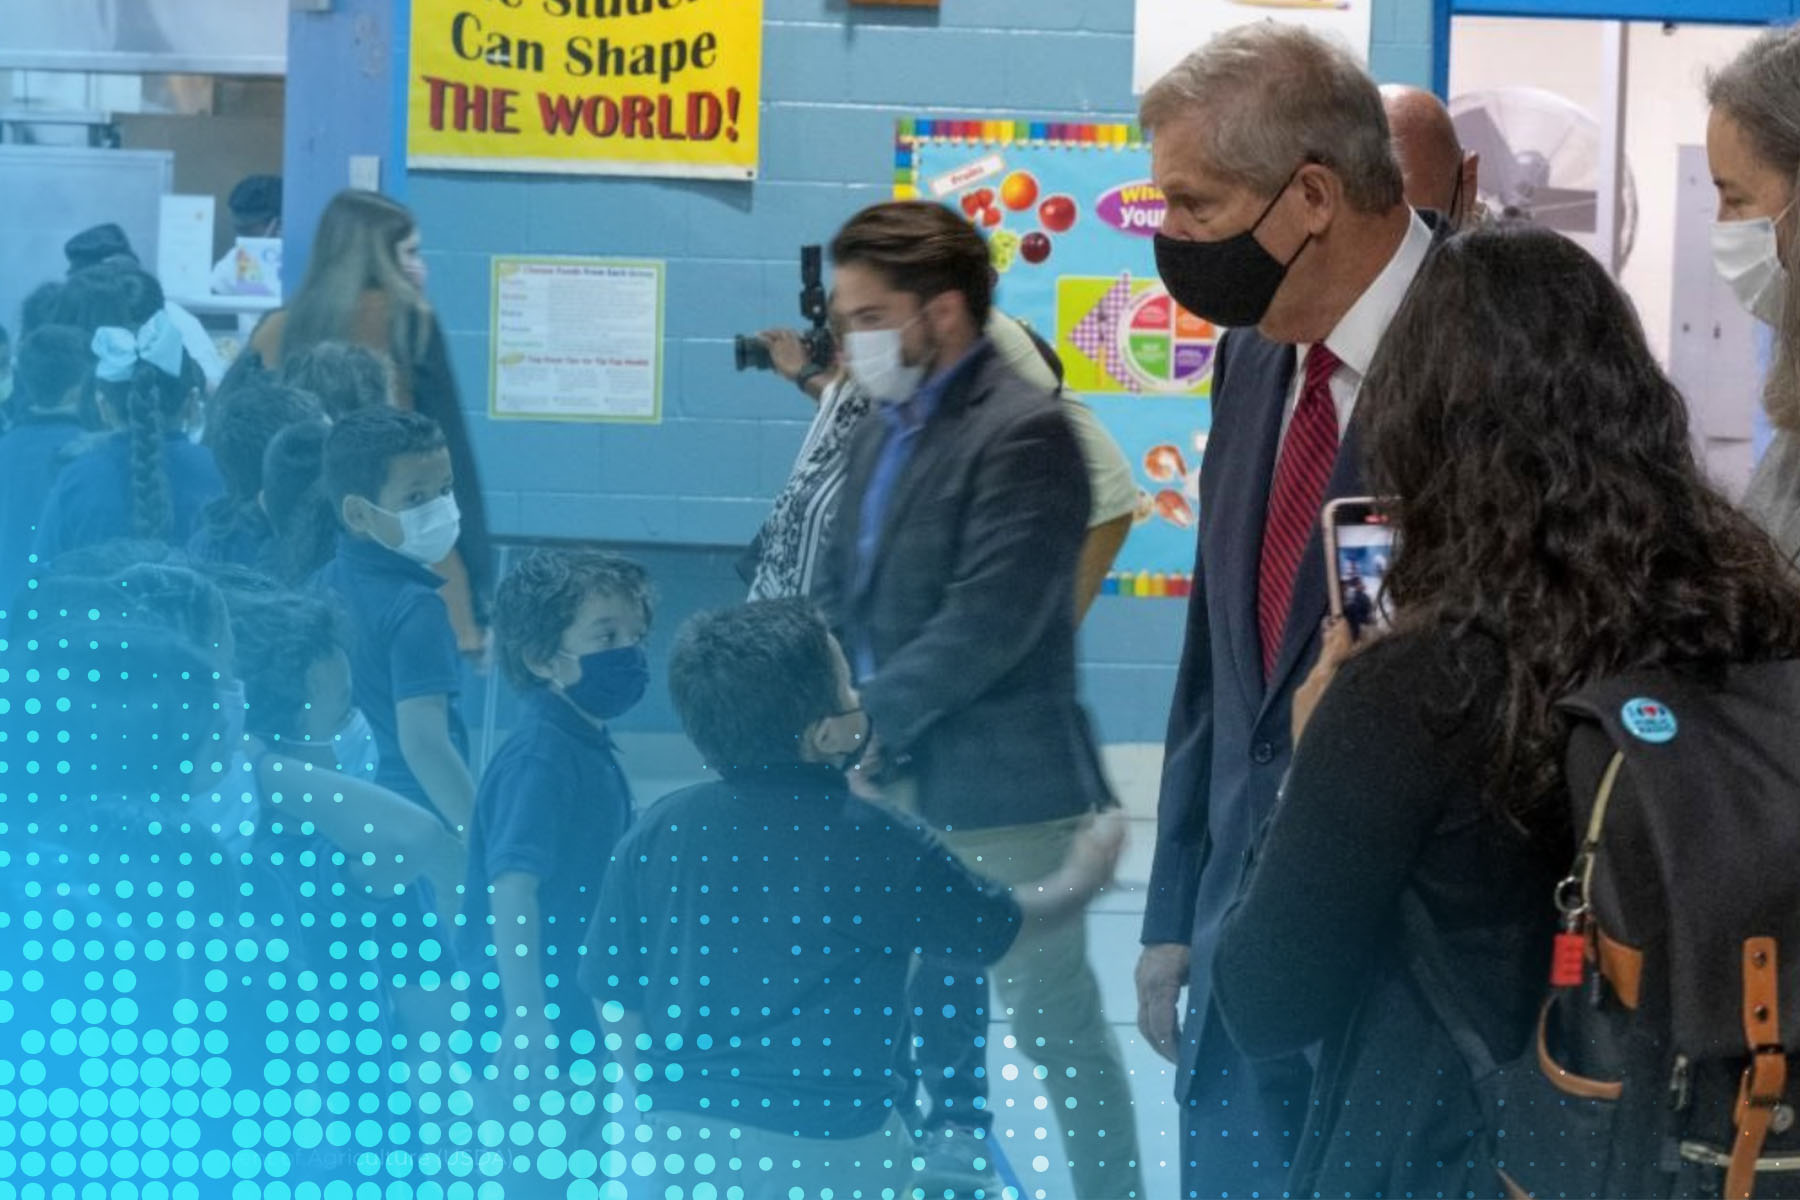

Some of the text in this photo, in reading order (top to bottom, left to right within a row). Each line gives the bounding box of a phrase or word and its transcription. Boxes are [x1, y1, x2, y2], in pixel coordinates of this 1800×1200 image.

[451, 11, 717, 84] Can Shape
[420, 74, 741, 143] THE WORLD!
[1121, 186, 1166, 205] Wha
